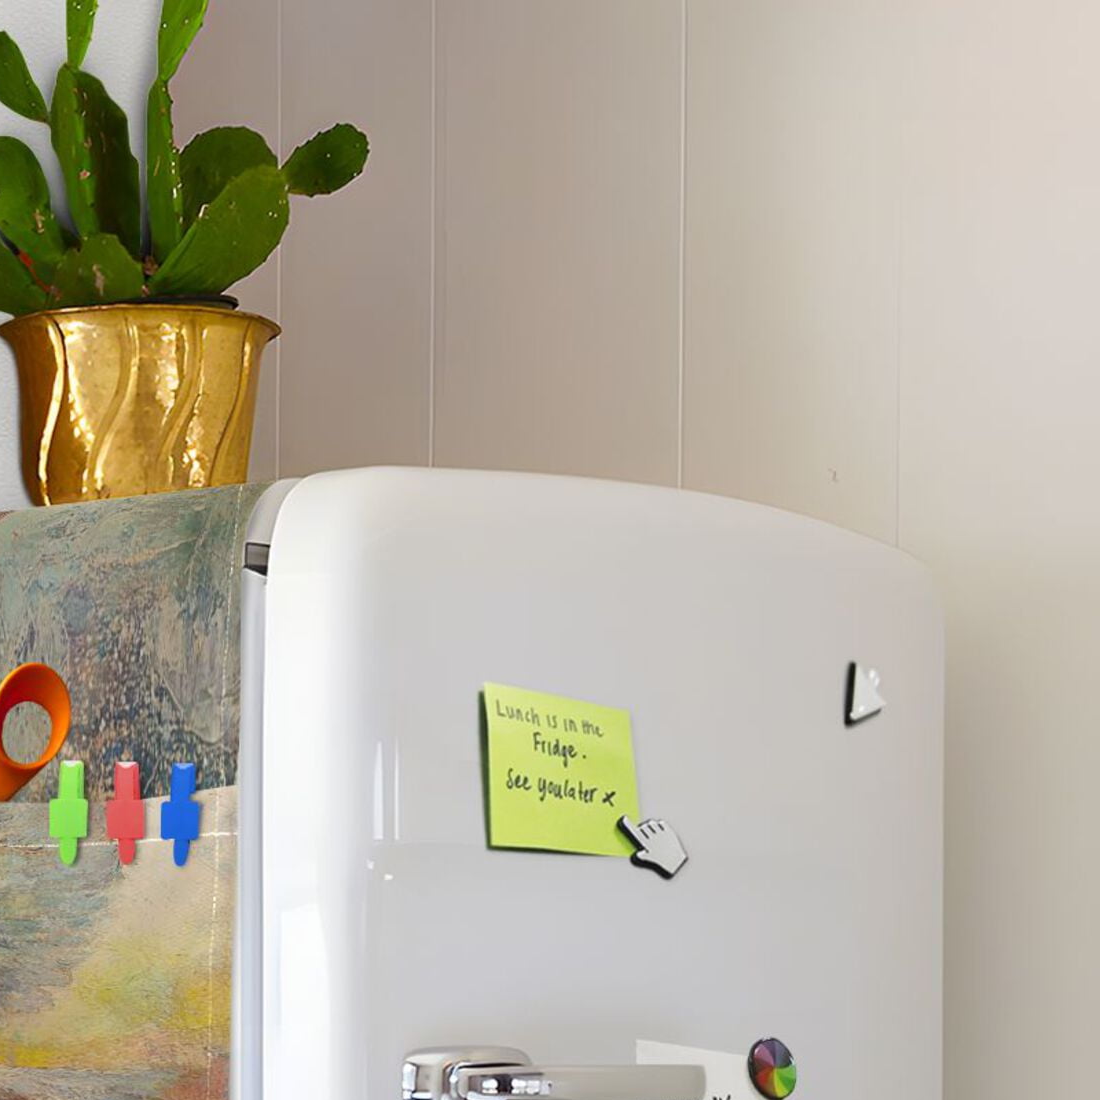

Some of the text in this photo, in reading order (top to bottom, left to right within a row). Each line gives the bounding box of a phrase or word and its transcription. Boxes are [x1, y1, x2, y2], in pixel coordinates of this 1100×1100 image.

[495, 699, 541, 728] Lunch
[582, 720, 604, 738] the
[506, 767, 532, 791] See
